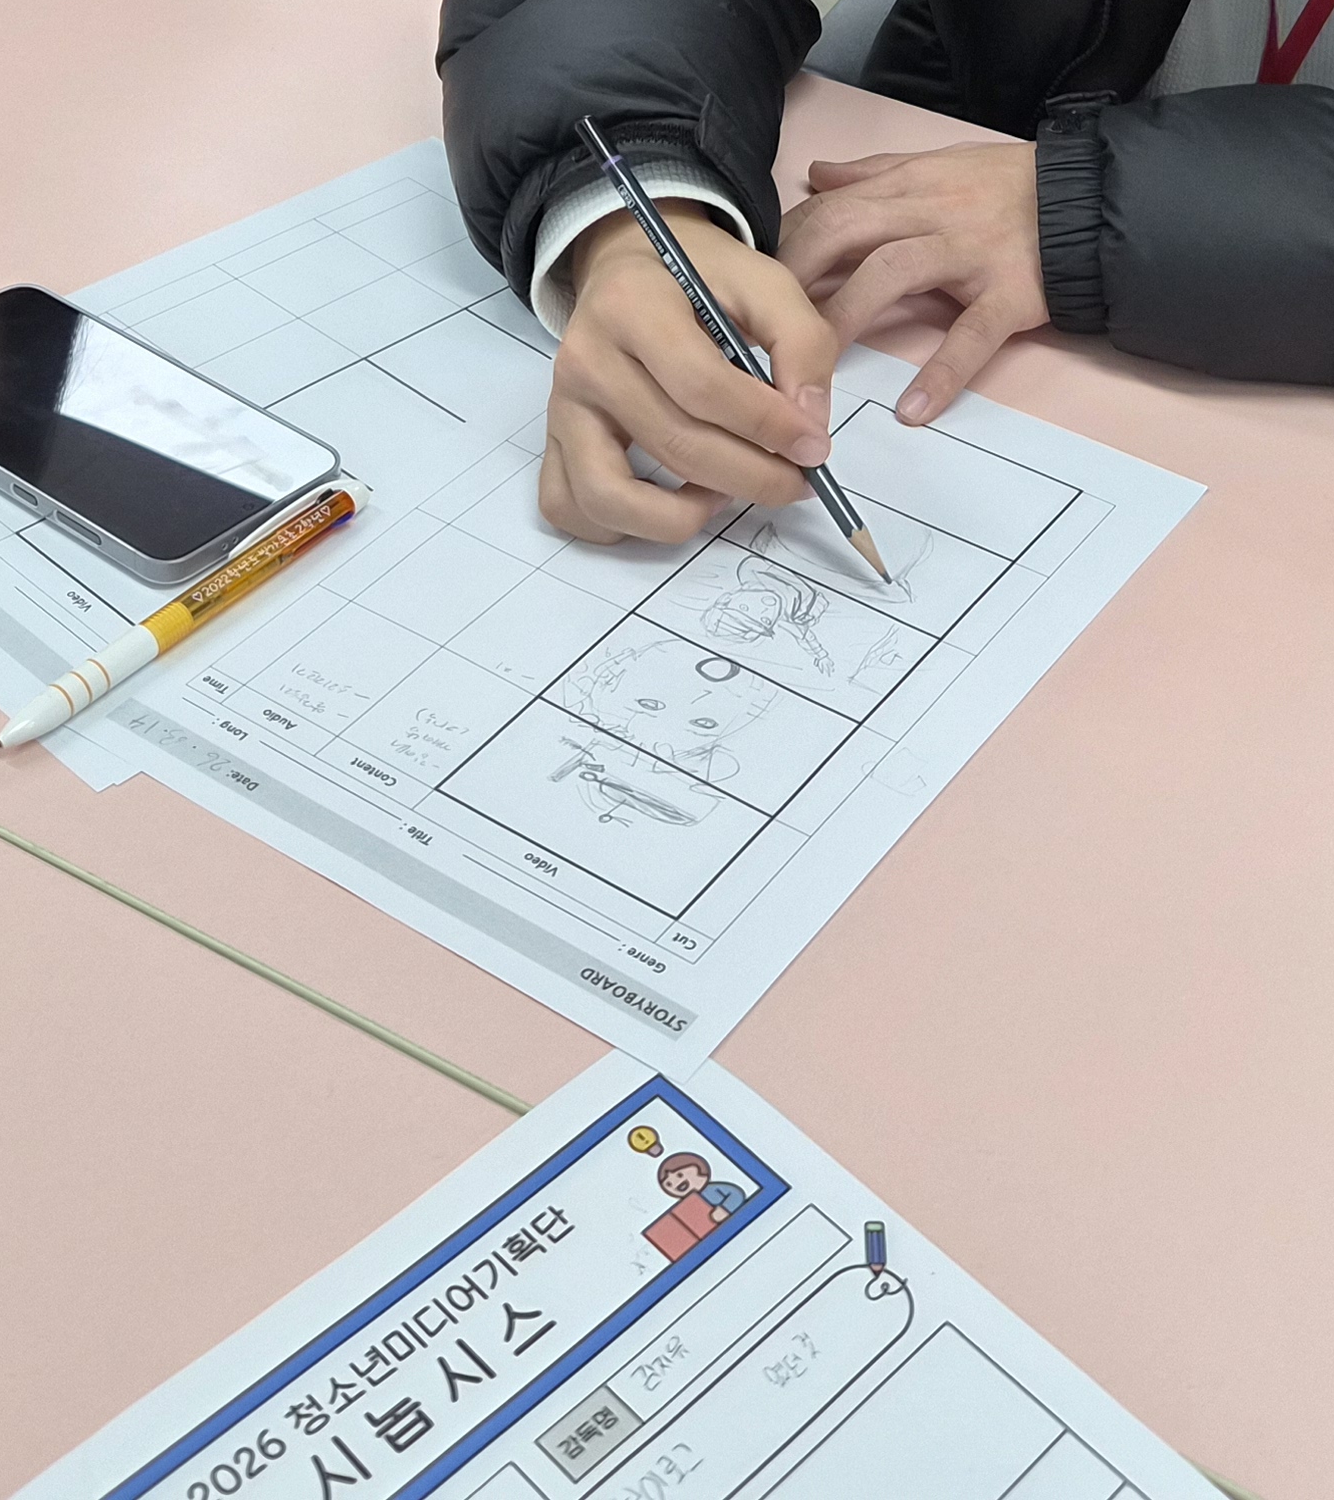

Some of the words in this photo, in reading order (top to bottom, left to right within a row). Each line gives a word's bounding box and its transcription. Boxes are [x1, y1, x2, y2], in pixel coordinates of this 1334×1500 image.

[66, 590, 93, 613] Video
[202, 675, 229, 694] Time
[262, 708, 298, 731] Audio
[350, 757, 398, 787] Content
[523, 852, 559, 878] Video
[672, 932, 698, 951] Cut
[580, 967, 688, 1032] STORYBOARD
[186, 1428, 287, 1500] 2026
[284, 1205, 576, 1436] 청소년미디어기획단
[557, 1405, 620, 1460] 감독명
